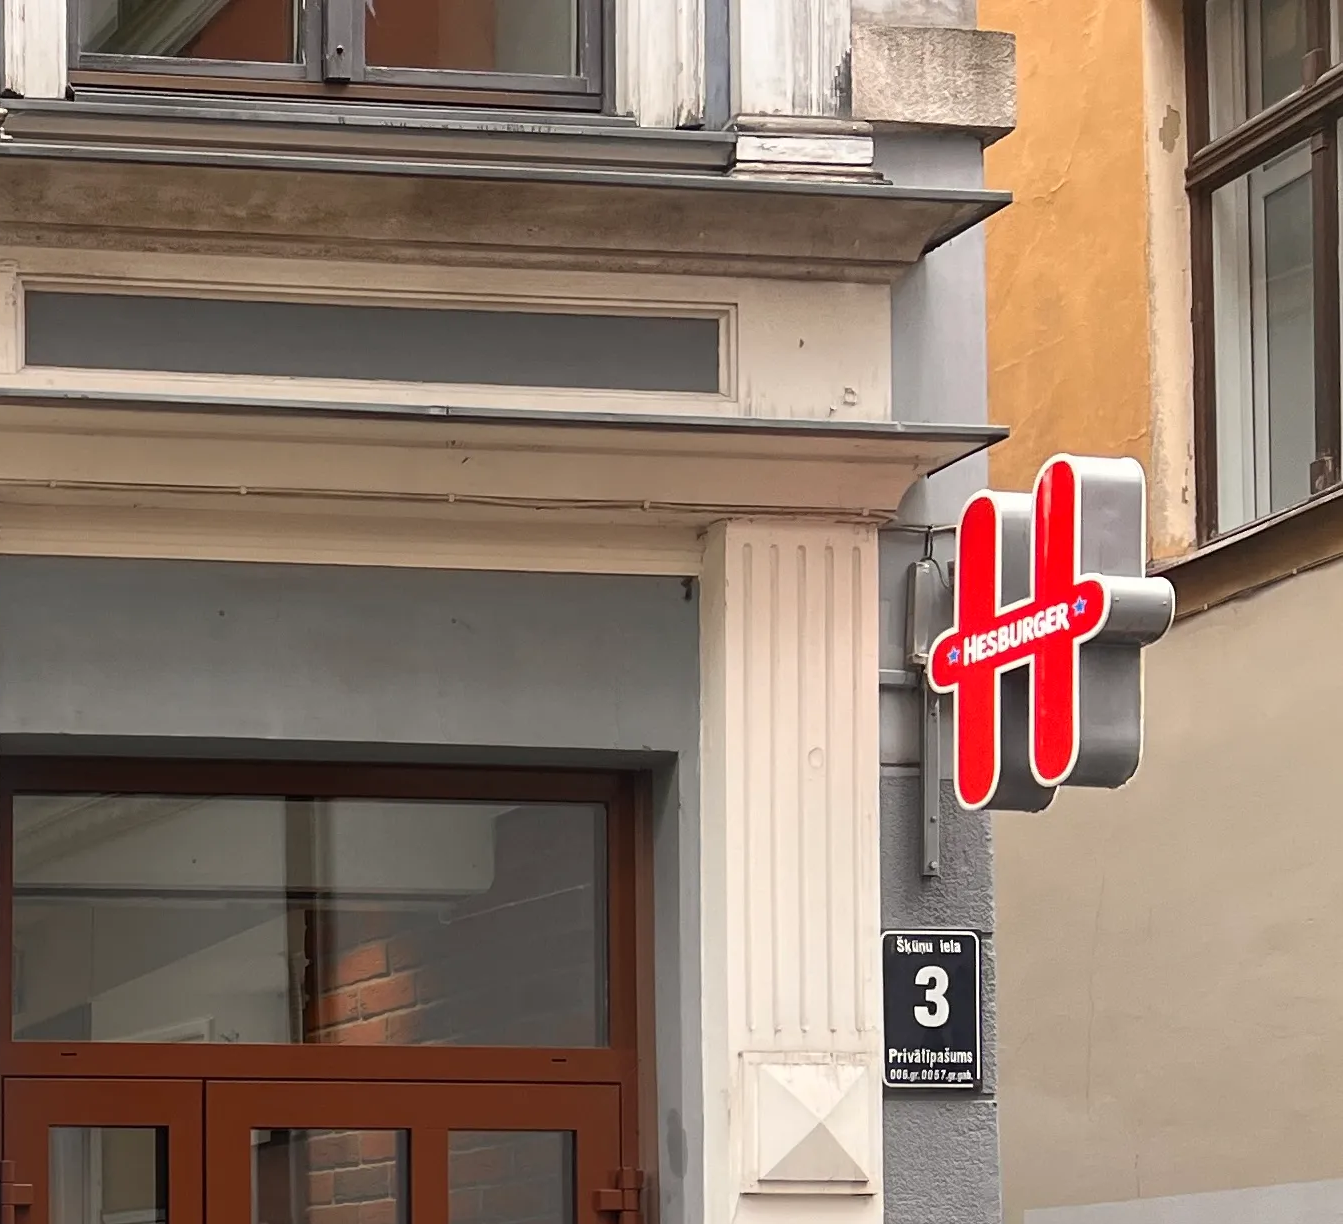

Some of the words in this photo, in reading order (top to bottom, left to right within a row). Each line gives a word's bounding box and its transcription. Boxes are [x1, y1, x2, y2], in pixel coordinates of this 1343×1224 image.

[929, 454, 1111, 809] H
[963, 602, 1071, 667] HESBURGER
[896, 936, 933, 954] Šķūņu
[940, 940, 962, 953] iela
[913, 965, 950, 1028] 3
[888, 1047, 973, 1068] Privātīpašums
